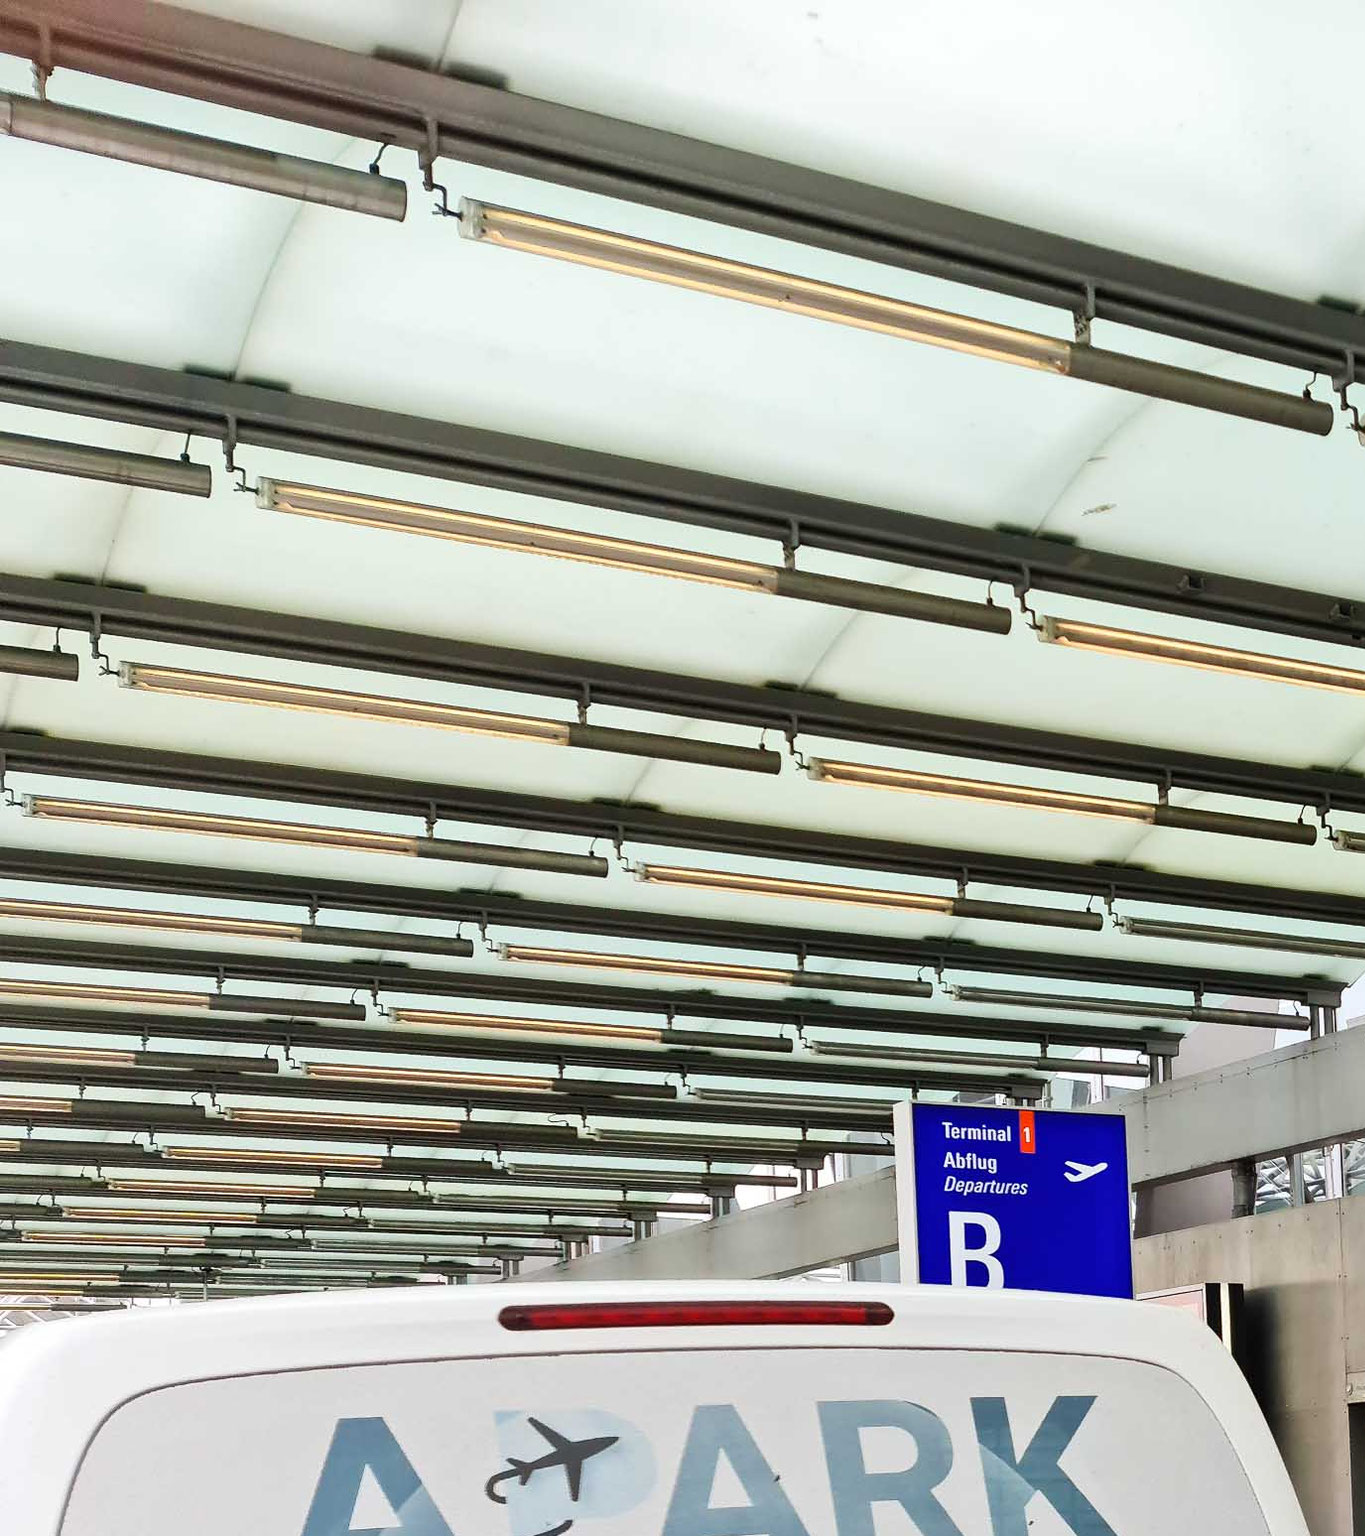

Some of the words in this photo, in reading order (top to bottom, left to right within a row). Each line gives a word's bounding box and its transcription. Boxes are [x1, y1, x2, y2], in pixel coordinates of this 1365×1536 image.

[942, 1121, 1012, 1143] Terminal
[1023, 1126, 1031, 1143] 1
[943, 1151, 998, 1174] Abflug
[944, 1176, 1028, 1196] Departures
[948, 1210, 1006, 1290] B
